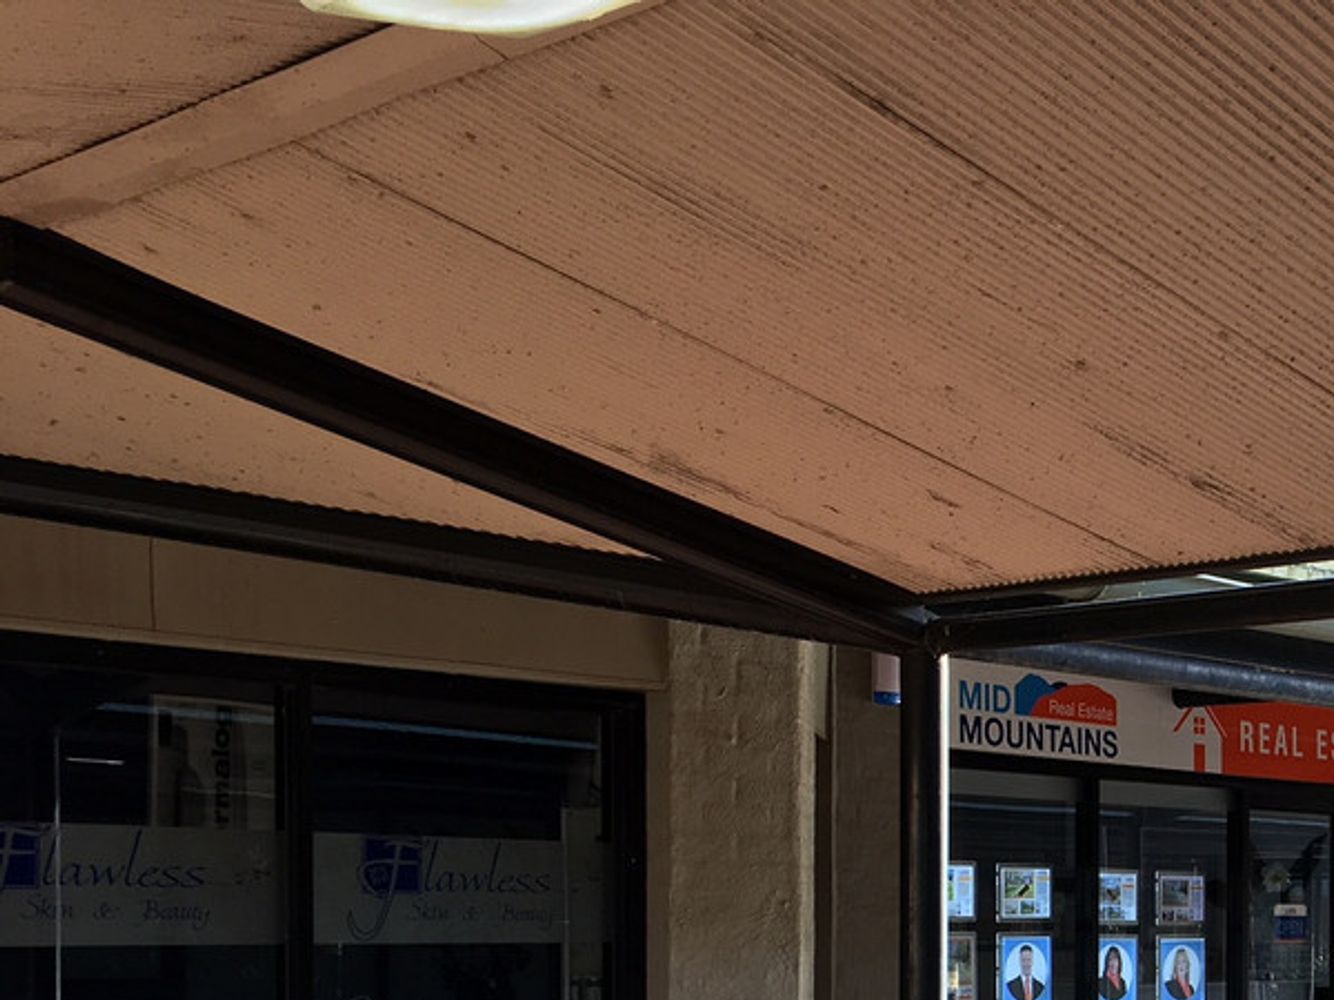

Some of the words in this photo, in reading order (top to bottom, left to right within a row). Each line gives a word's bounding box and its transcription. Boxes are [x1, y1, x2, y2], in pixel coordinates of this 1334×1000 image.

[959, 680, 1011, 713] MID
[1048, 699, 1075, 717] Real
[1078, 702, 1114, 721] Estate
[959, 714, 1119, 759] MOUNTAINS
[1239, 719, 1304, 758] REAL
